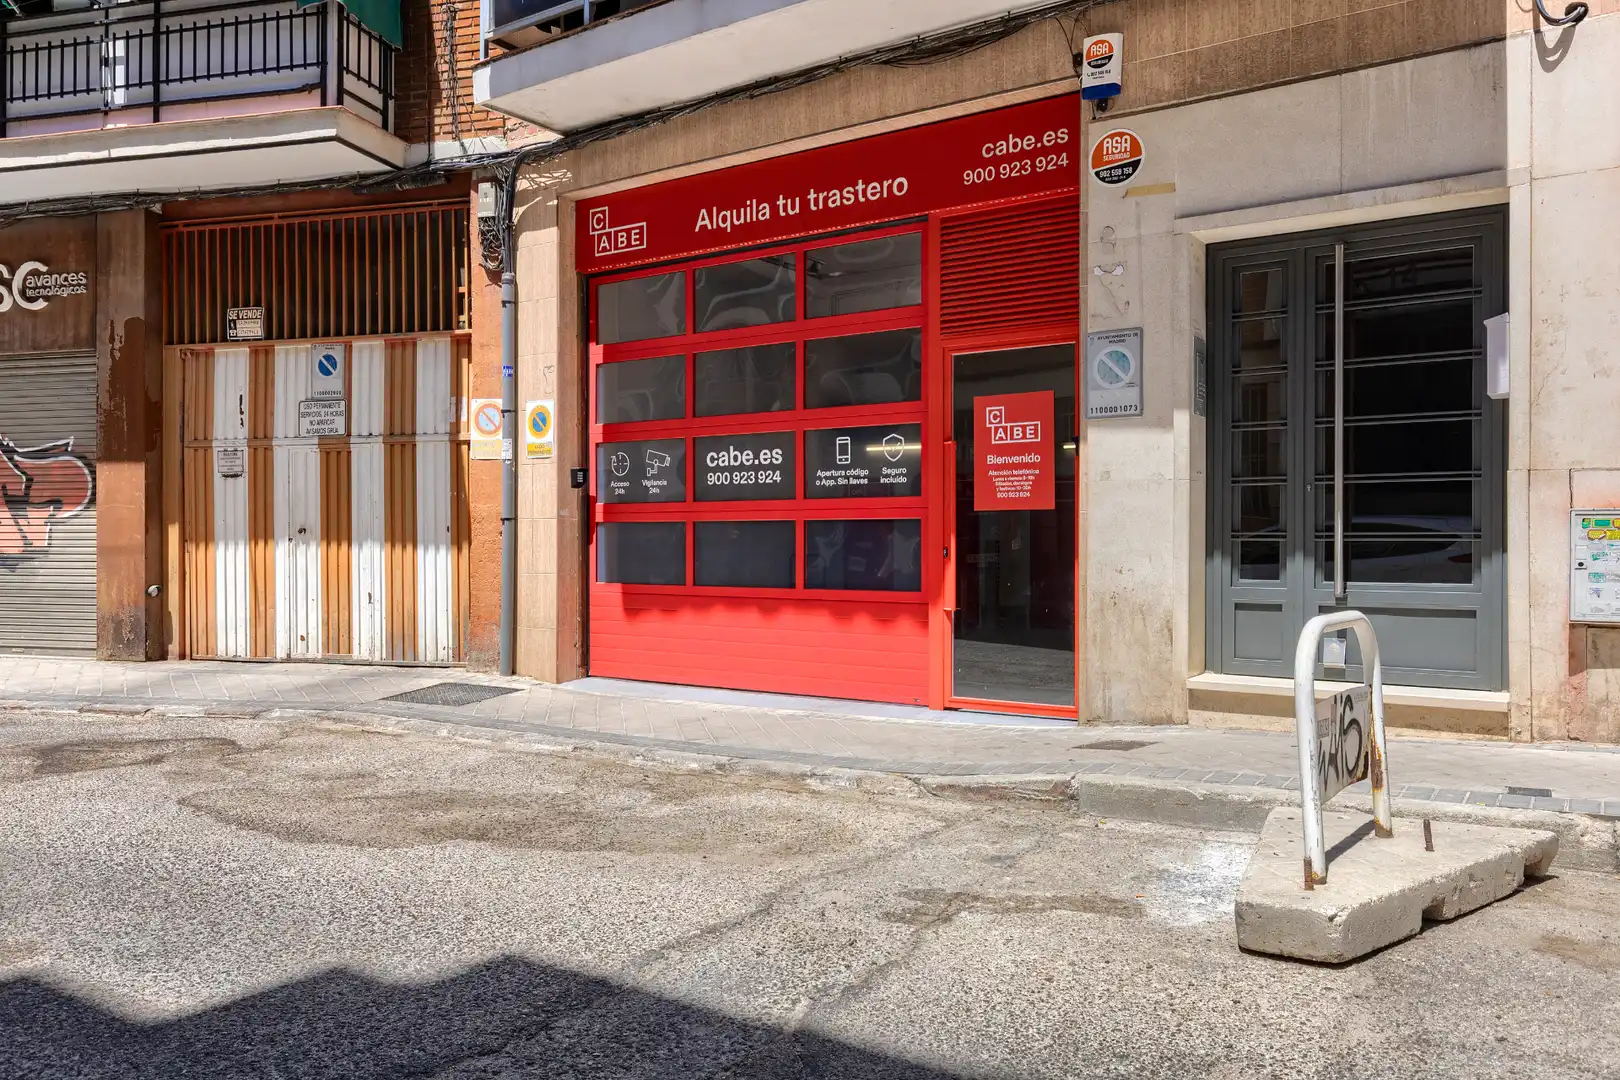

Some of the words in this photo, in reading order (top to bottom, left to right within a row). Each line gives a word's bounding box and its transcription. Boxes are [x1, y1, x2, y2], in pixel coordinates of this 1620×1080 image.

[1090, 42, 1109, 57] ASA
[981, 128, 1069, 158] cabe.es
[1103, 135, 1131, 155] ASA
[963, 166, 995, 185] 900
[999, 159, 1031, 179] 923
[1035, 152, 1069, 173] 924
[694, 199, 771, 233] Alquila
[777, 194, 800, 217] tu
[807, 176, 909, 211] trastero
[25, 272, 87, 288] avances
[228, 310, 238, 320] SE
[238, 309, 262, 319] VENDE
[705, 445, 783, 468] cabe.es
[987, 453, 1041, 465] Bienvenido
[706, 472, 730, 486] 900
[732, 471, 756, 485] 923
[757, 470, 782, 484] 924
[816, 469, 845, 478] Apertura
[846, 467, 869, 477] código
[882, 467, 907, 476] Seguro
[610, 480, 630, 488] Acceso
[641, 478, 668, 488] Vigilancia
[837, 477, 848, 485] Sin
[648, 486, 660, 494] 24h
